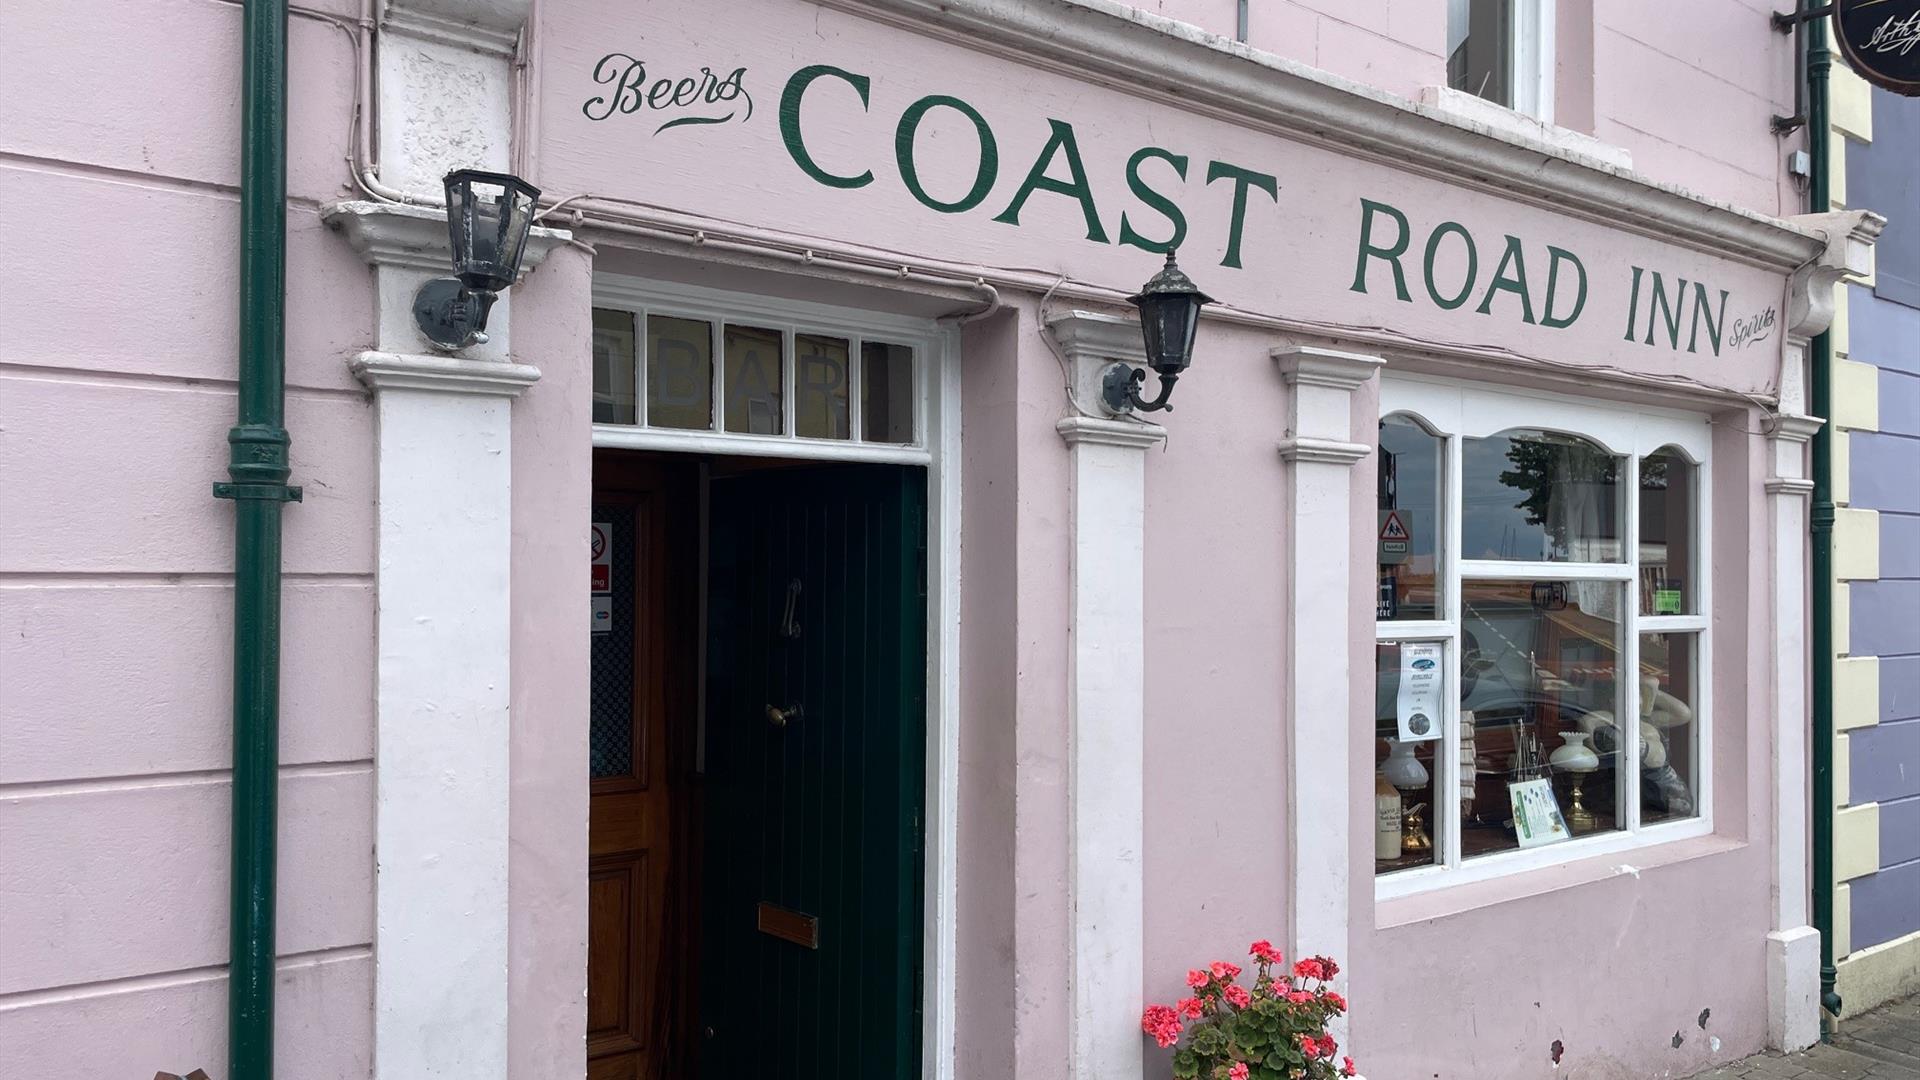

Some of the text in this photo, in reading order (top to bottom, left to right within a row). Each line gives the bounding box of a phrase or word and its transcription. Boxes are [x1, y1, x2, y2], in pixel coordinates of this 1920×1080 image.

[583, 53, 753, 124] Beers
[779, 64, 1730, 357] COAST ROAD INN
[1728, 305, 1777, 350] Spirits
[656, 338, 846, 420] BAR
